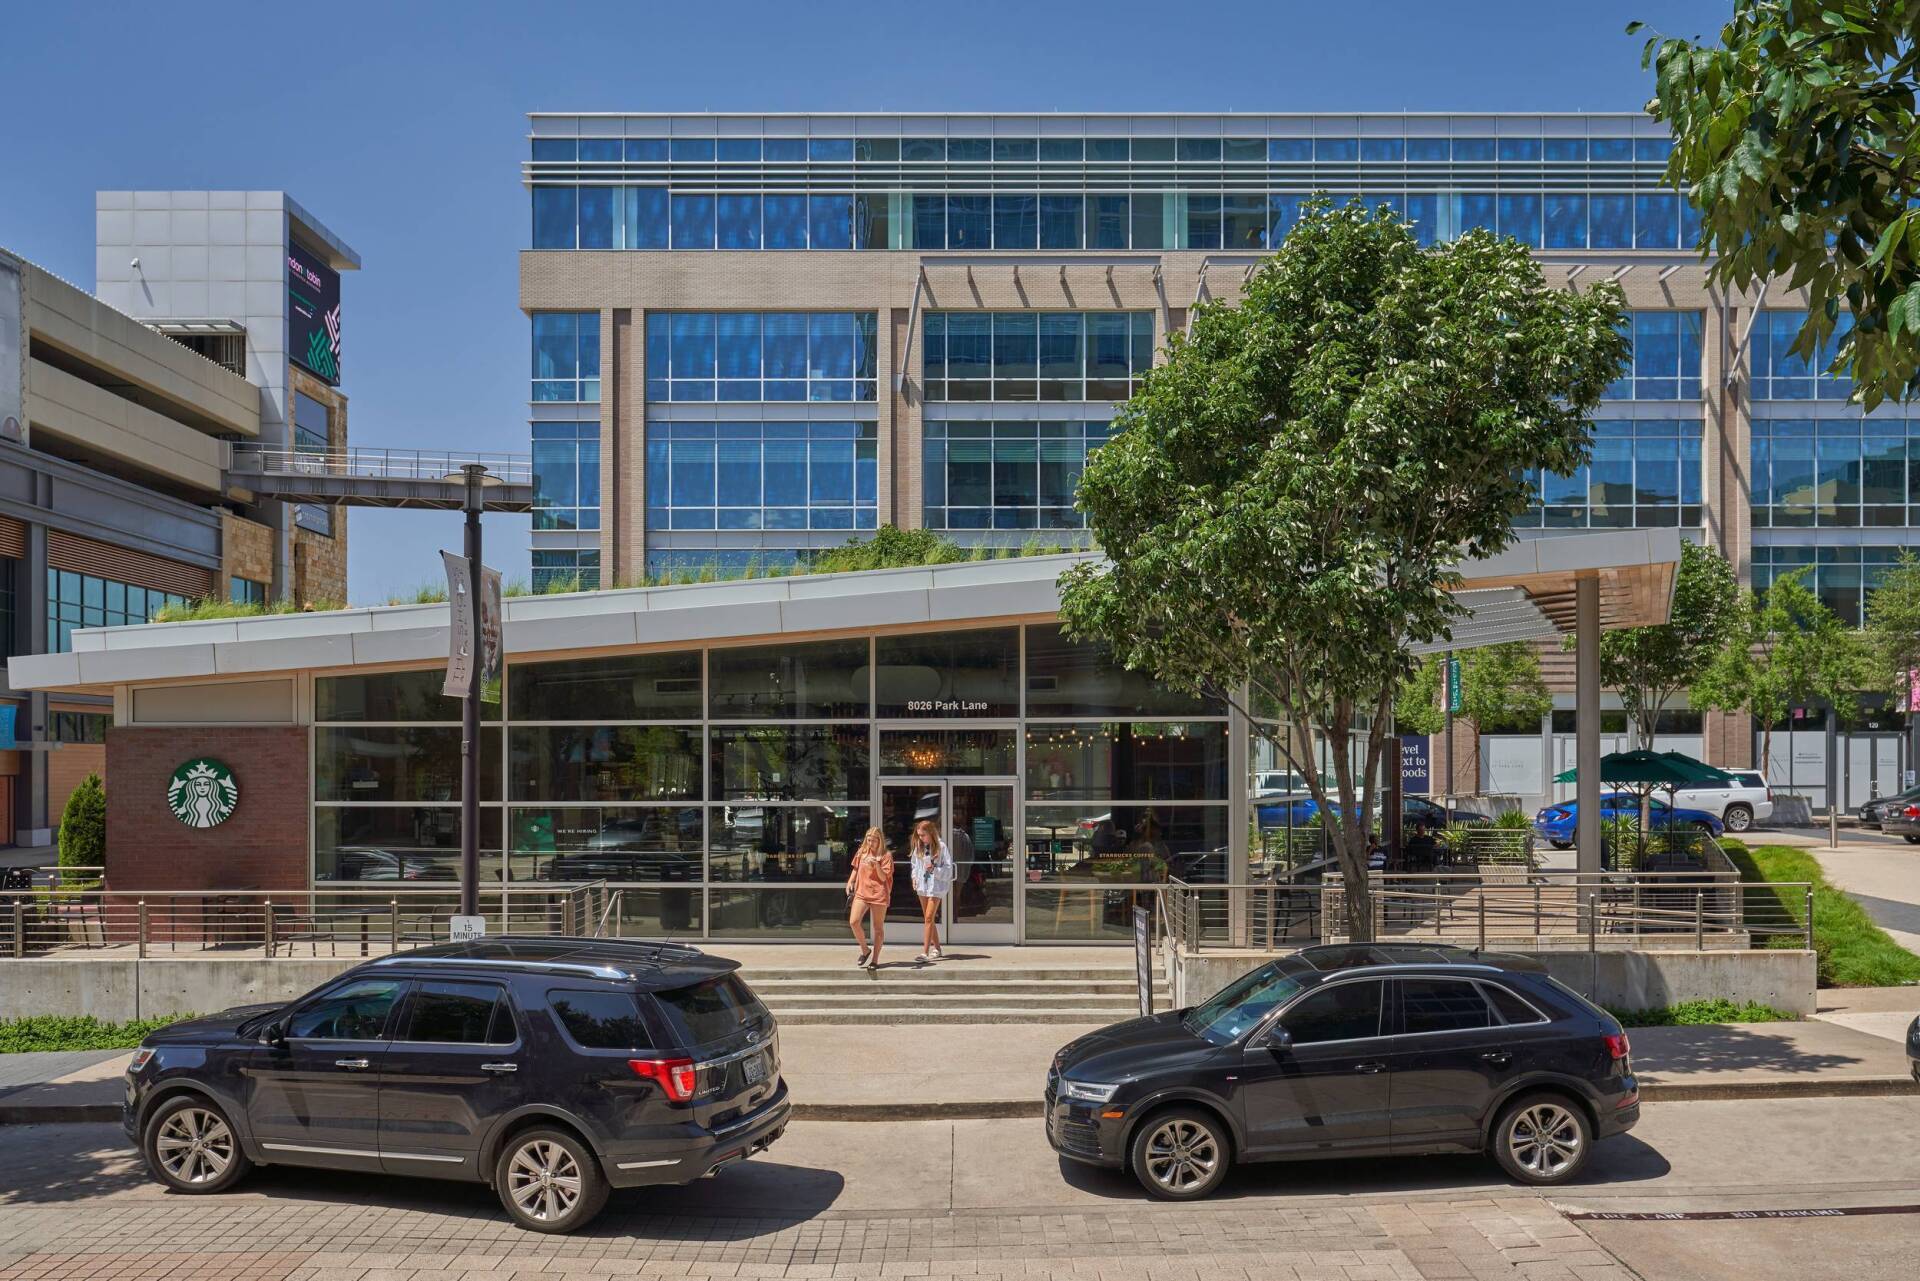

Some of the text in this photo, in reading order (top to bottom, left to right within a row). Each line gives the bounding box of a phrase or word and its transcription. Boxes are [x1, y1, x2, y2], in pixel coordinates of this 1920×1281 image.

[306, 268, 321, 287] tobin
[908, 700, 988, 710] 8026 Park Lane
[1402, 757, 1426, 766] xt to
[1402, 768, 1427, 777] oods
[464, 924, 473, 932] 15
[1764, 1209, 1845, 1217] PARKING
